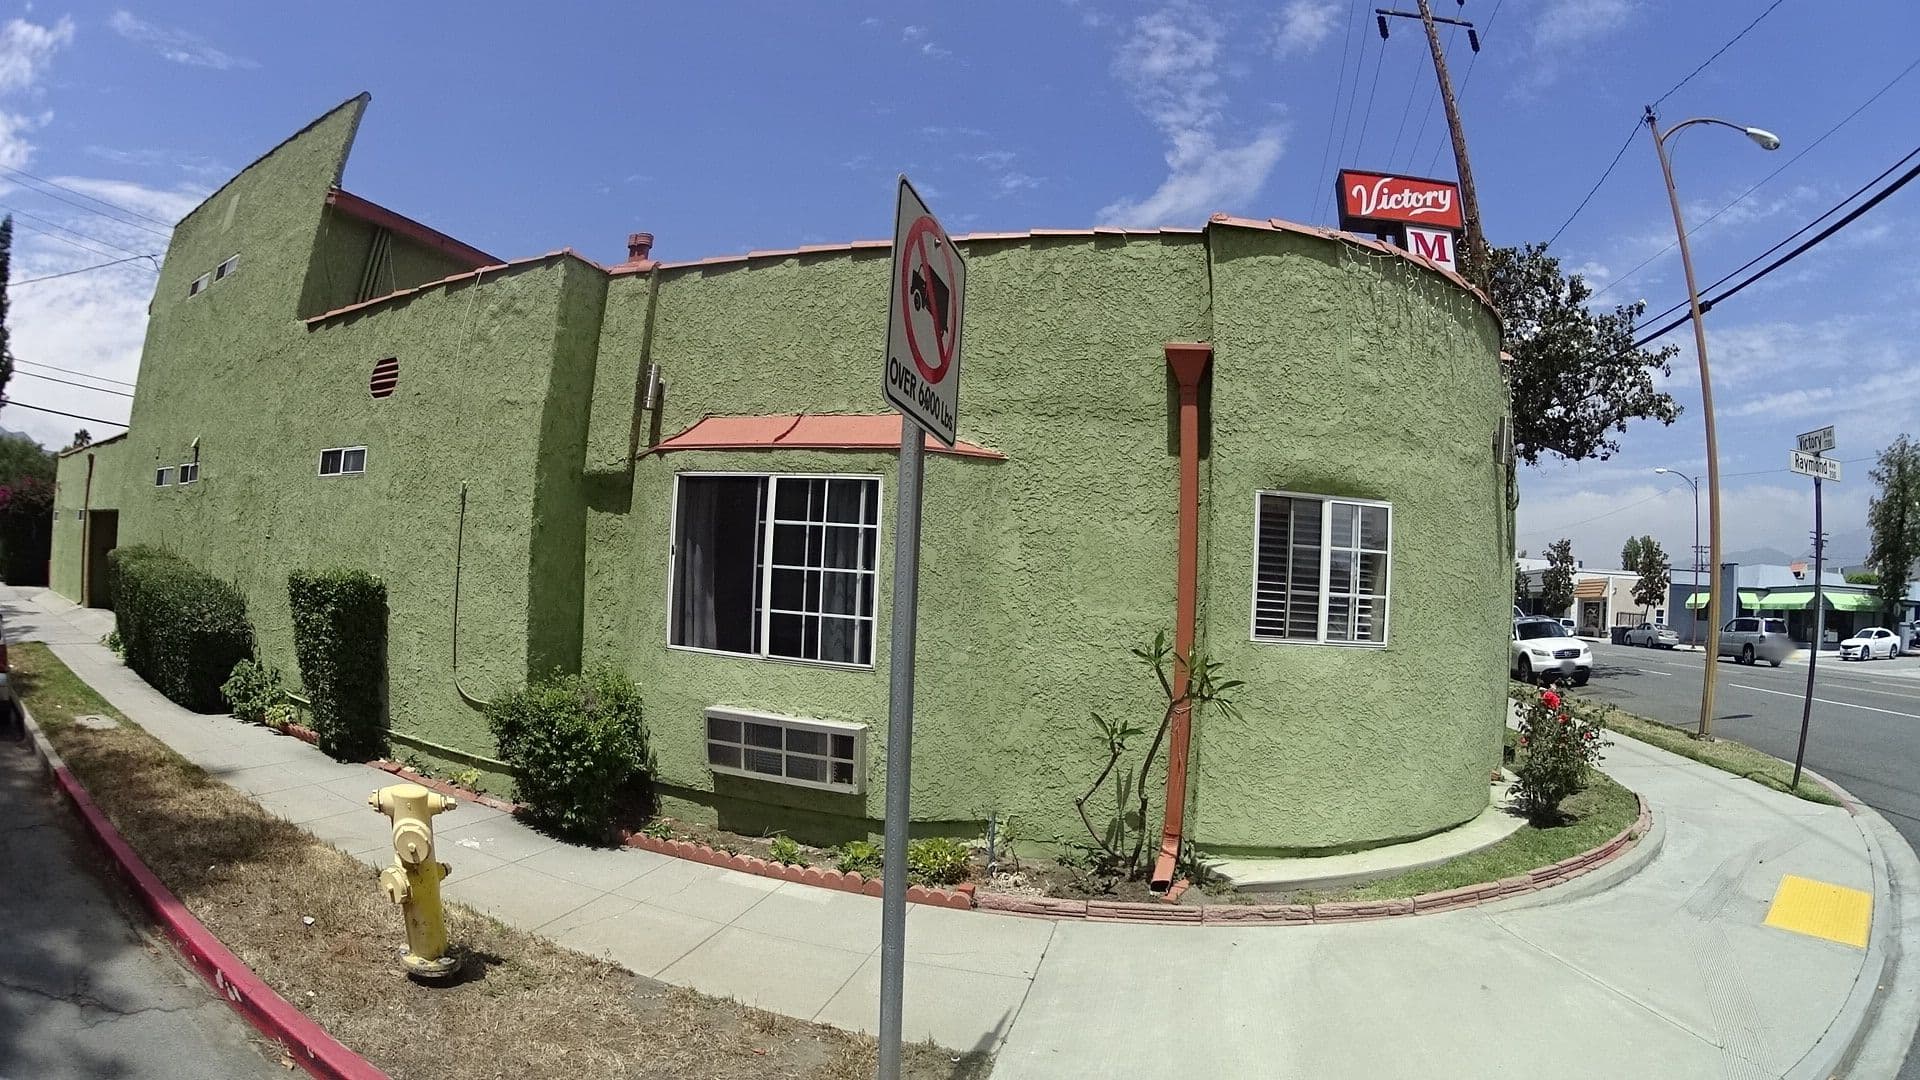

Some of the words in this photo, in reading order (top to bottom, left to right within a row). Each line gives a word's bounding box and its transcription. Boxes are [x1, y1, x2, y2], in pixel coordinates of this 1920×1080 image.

[1352, 177, 1451, 216] Victory
[1410, 231, 1450, 263] M
[889, 356, 917, 401] OVER
[1798, 434, 1822, 451] Victory
[1794, 453, 1828, 475] Raymond
